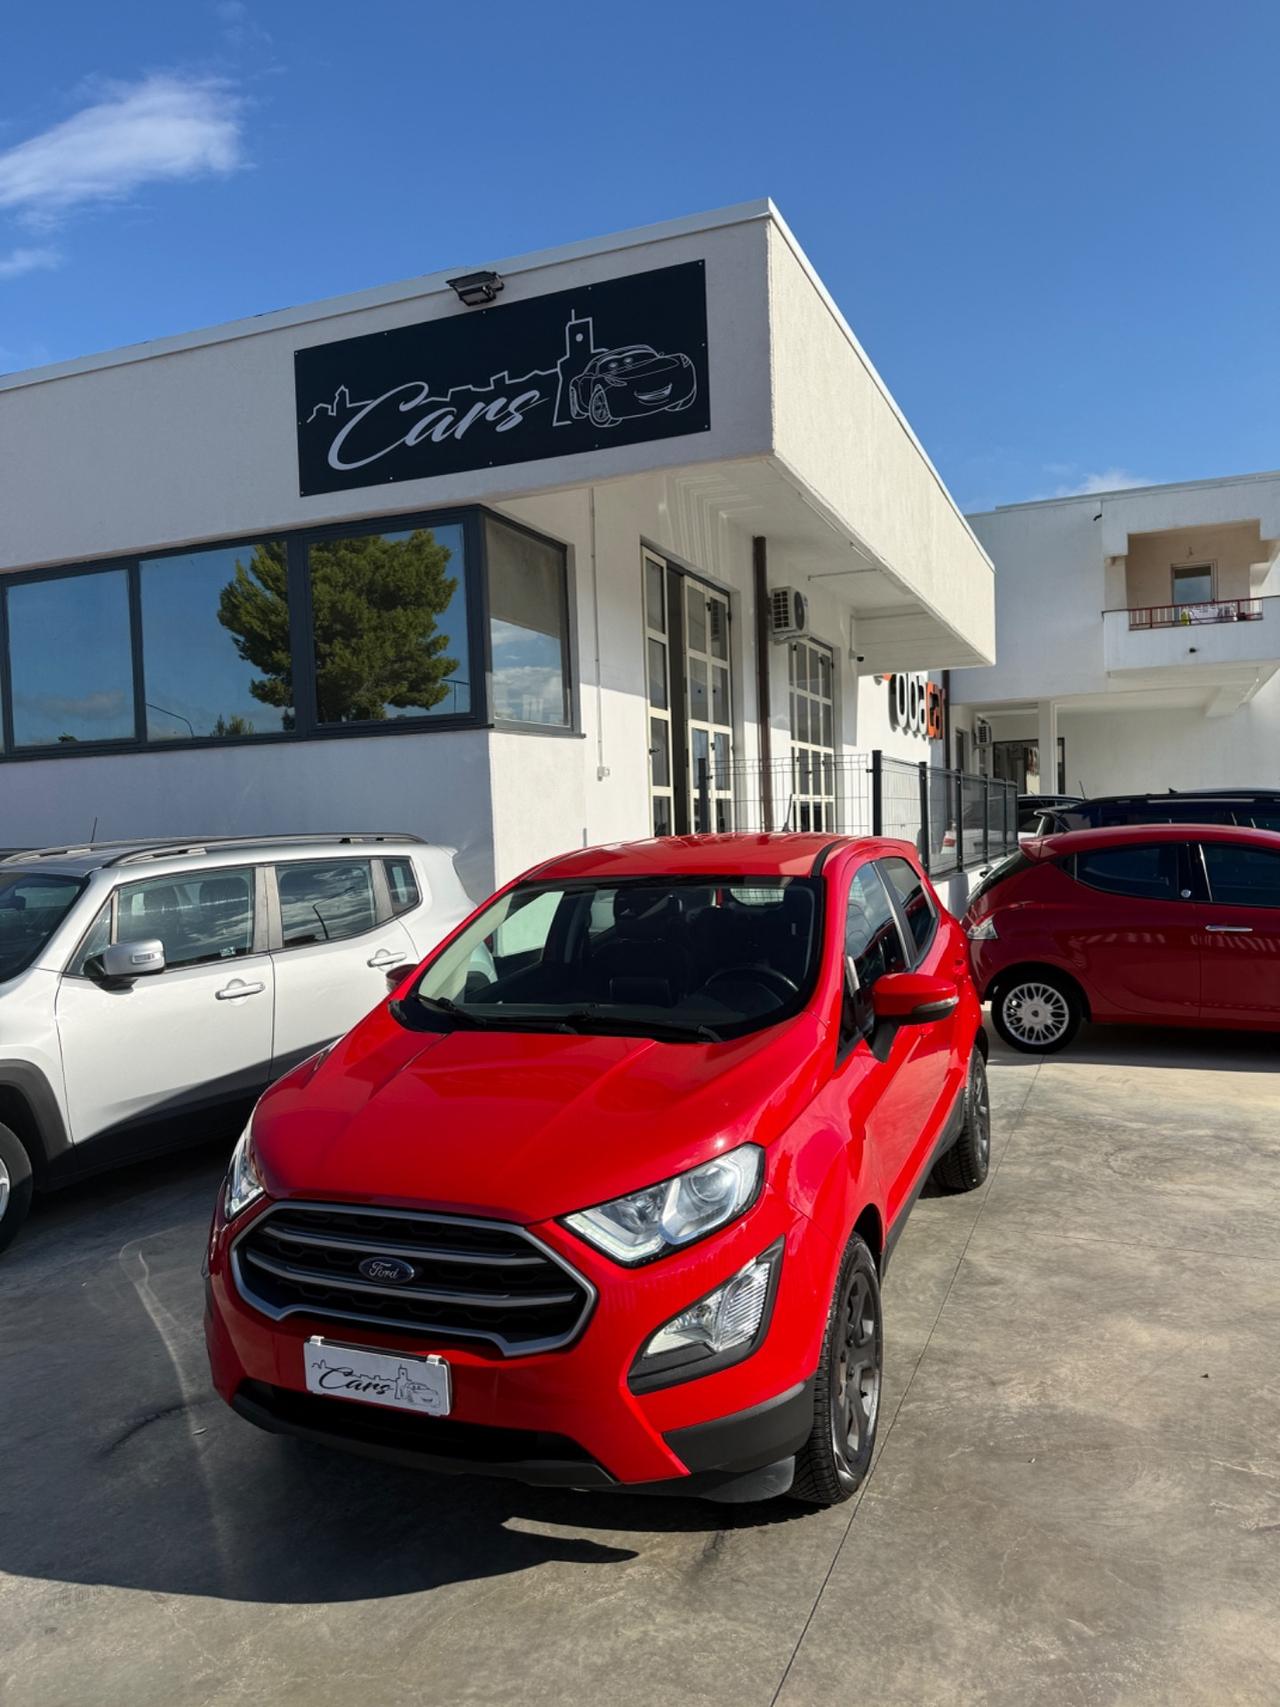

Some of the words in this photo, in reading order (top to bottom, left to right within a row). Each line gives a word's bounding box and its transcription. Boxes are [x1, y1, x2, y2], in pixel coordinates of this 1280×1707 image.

[328, 382, 547, 470] Cars
[368, 1261, 399, 1279] Ford
[319, 1367, 391, 1395] Cars
